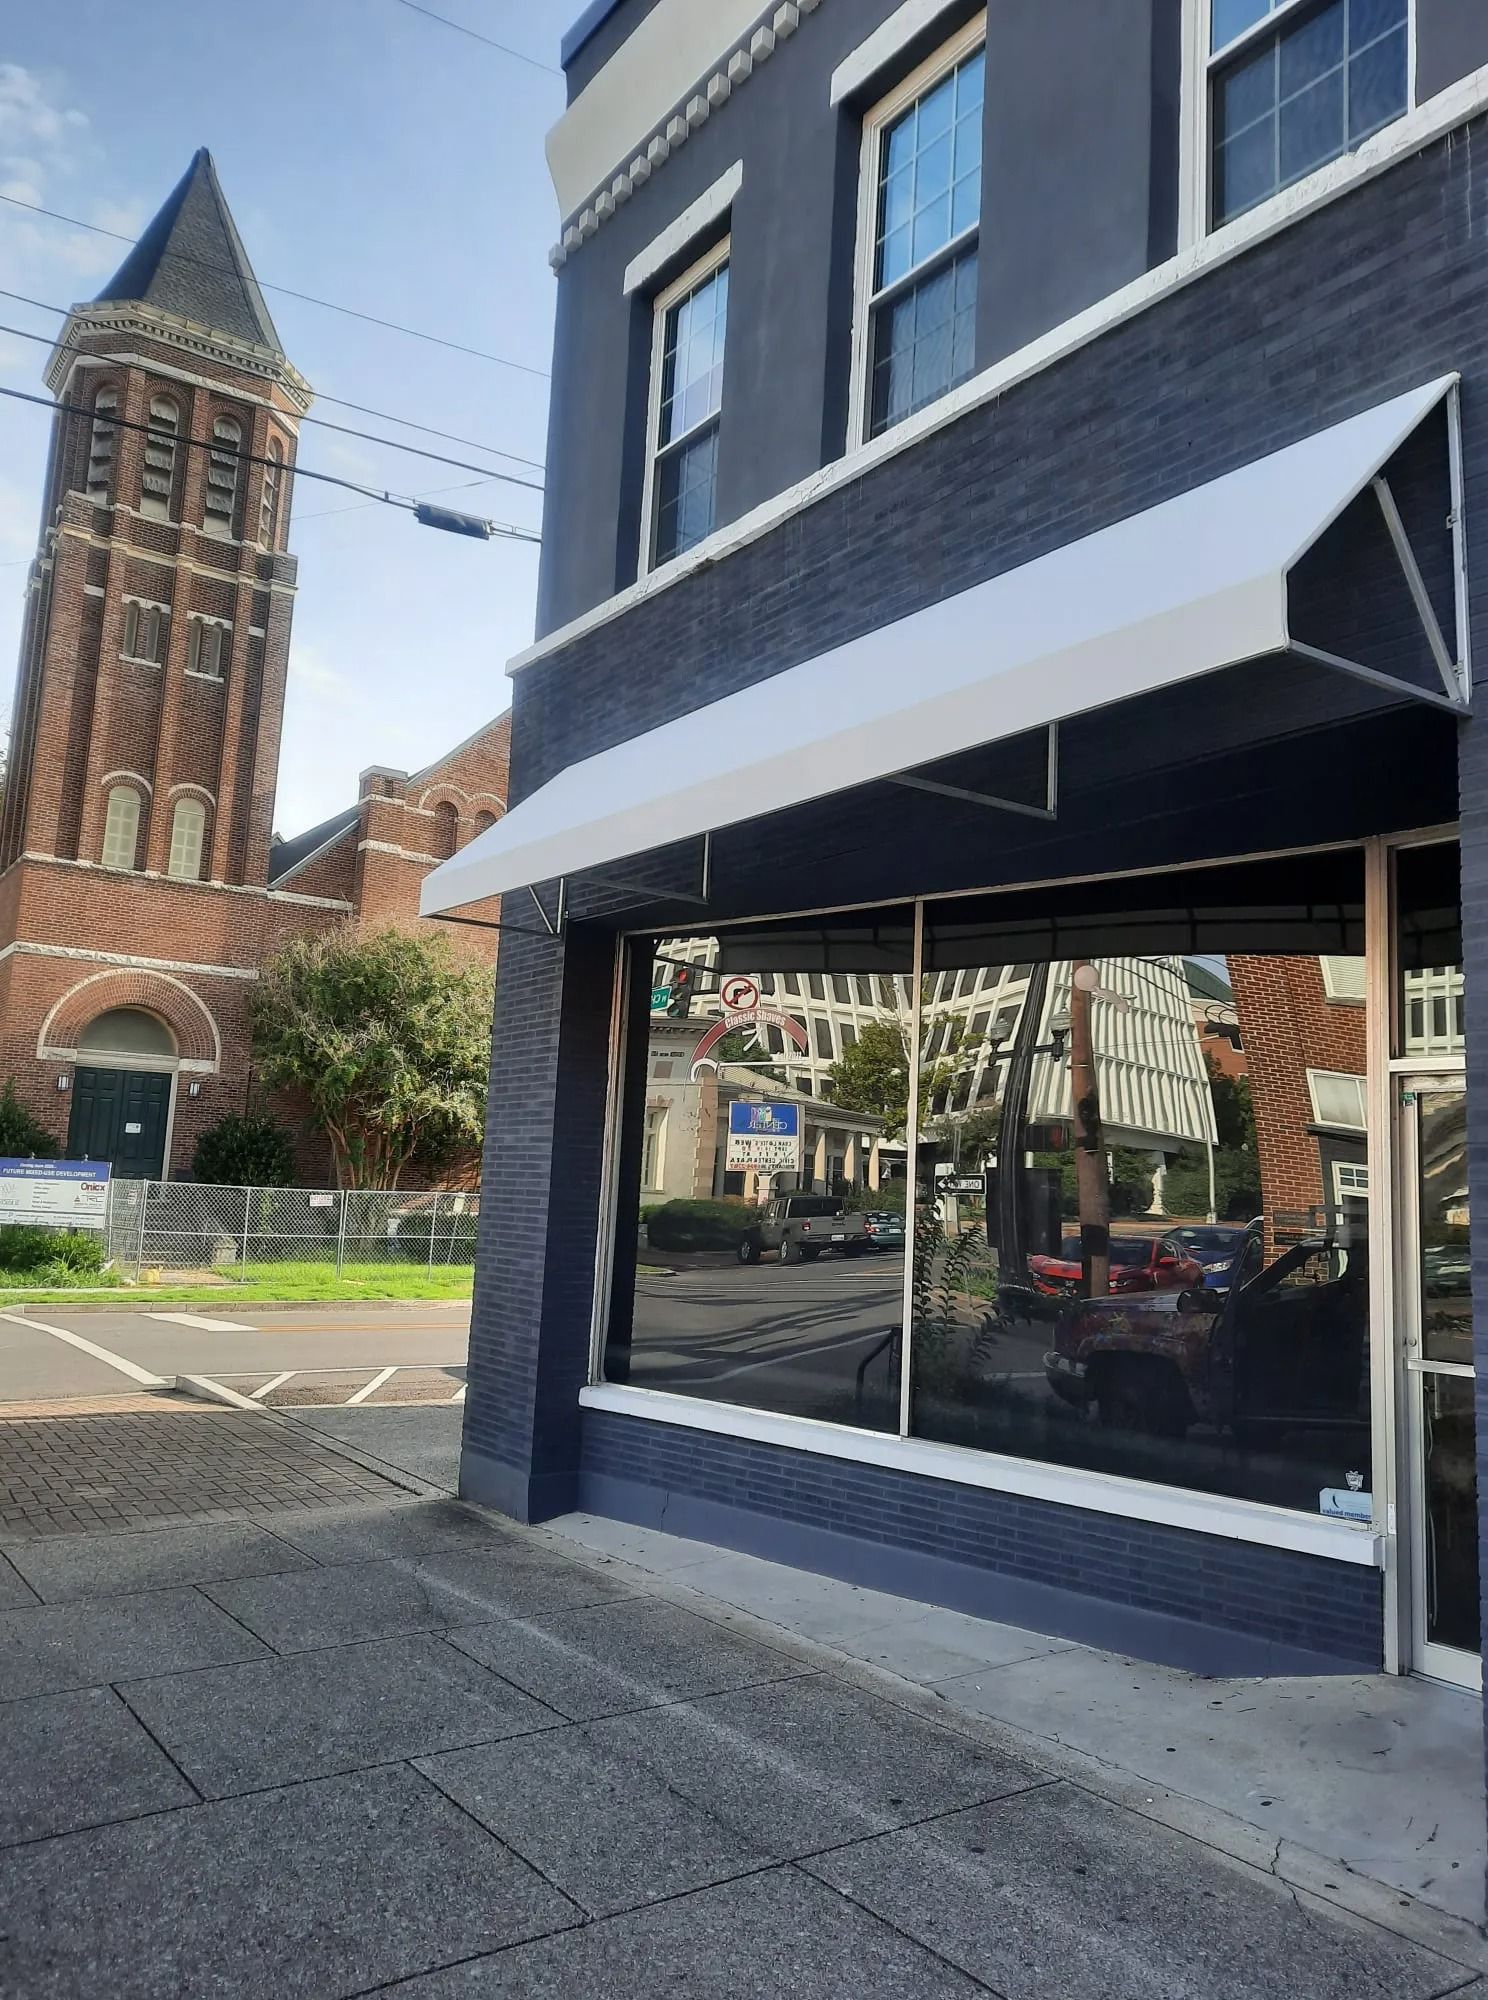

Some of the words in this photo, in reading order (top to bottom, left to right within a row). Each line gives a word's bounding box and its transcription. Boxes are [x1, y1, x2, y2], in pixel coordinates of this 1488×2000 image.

[724, 1010, 756, 1029] Classic
[756, 1010, 786, 1027] Shaves
[56, 1170, 97, 1178] DEVELOPMENT
[81, 1182, 105, 1191] Onicx
[1322, 1508, 1344, 1516] valued
[1344, 1511, 1372, 1520] member
